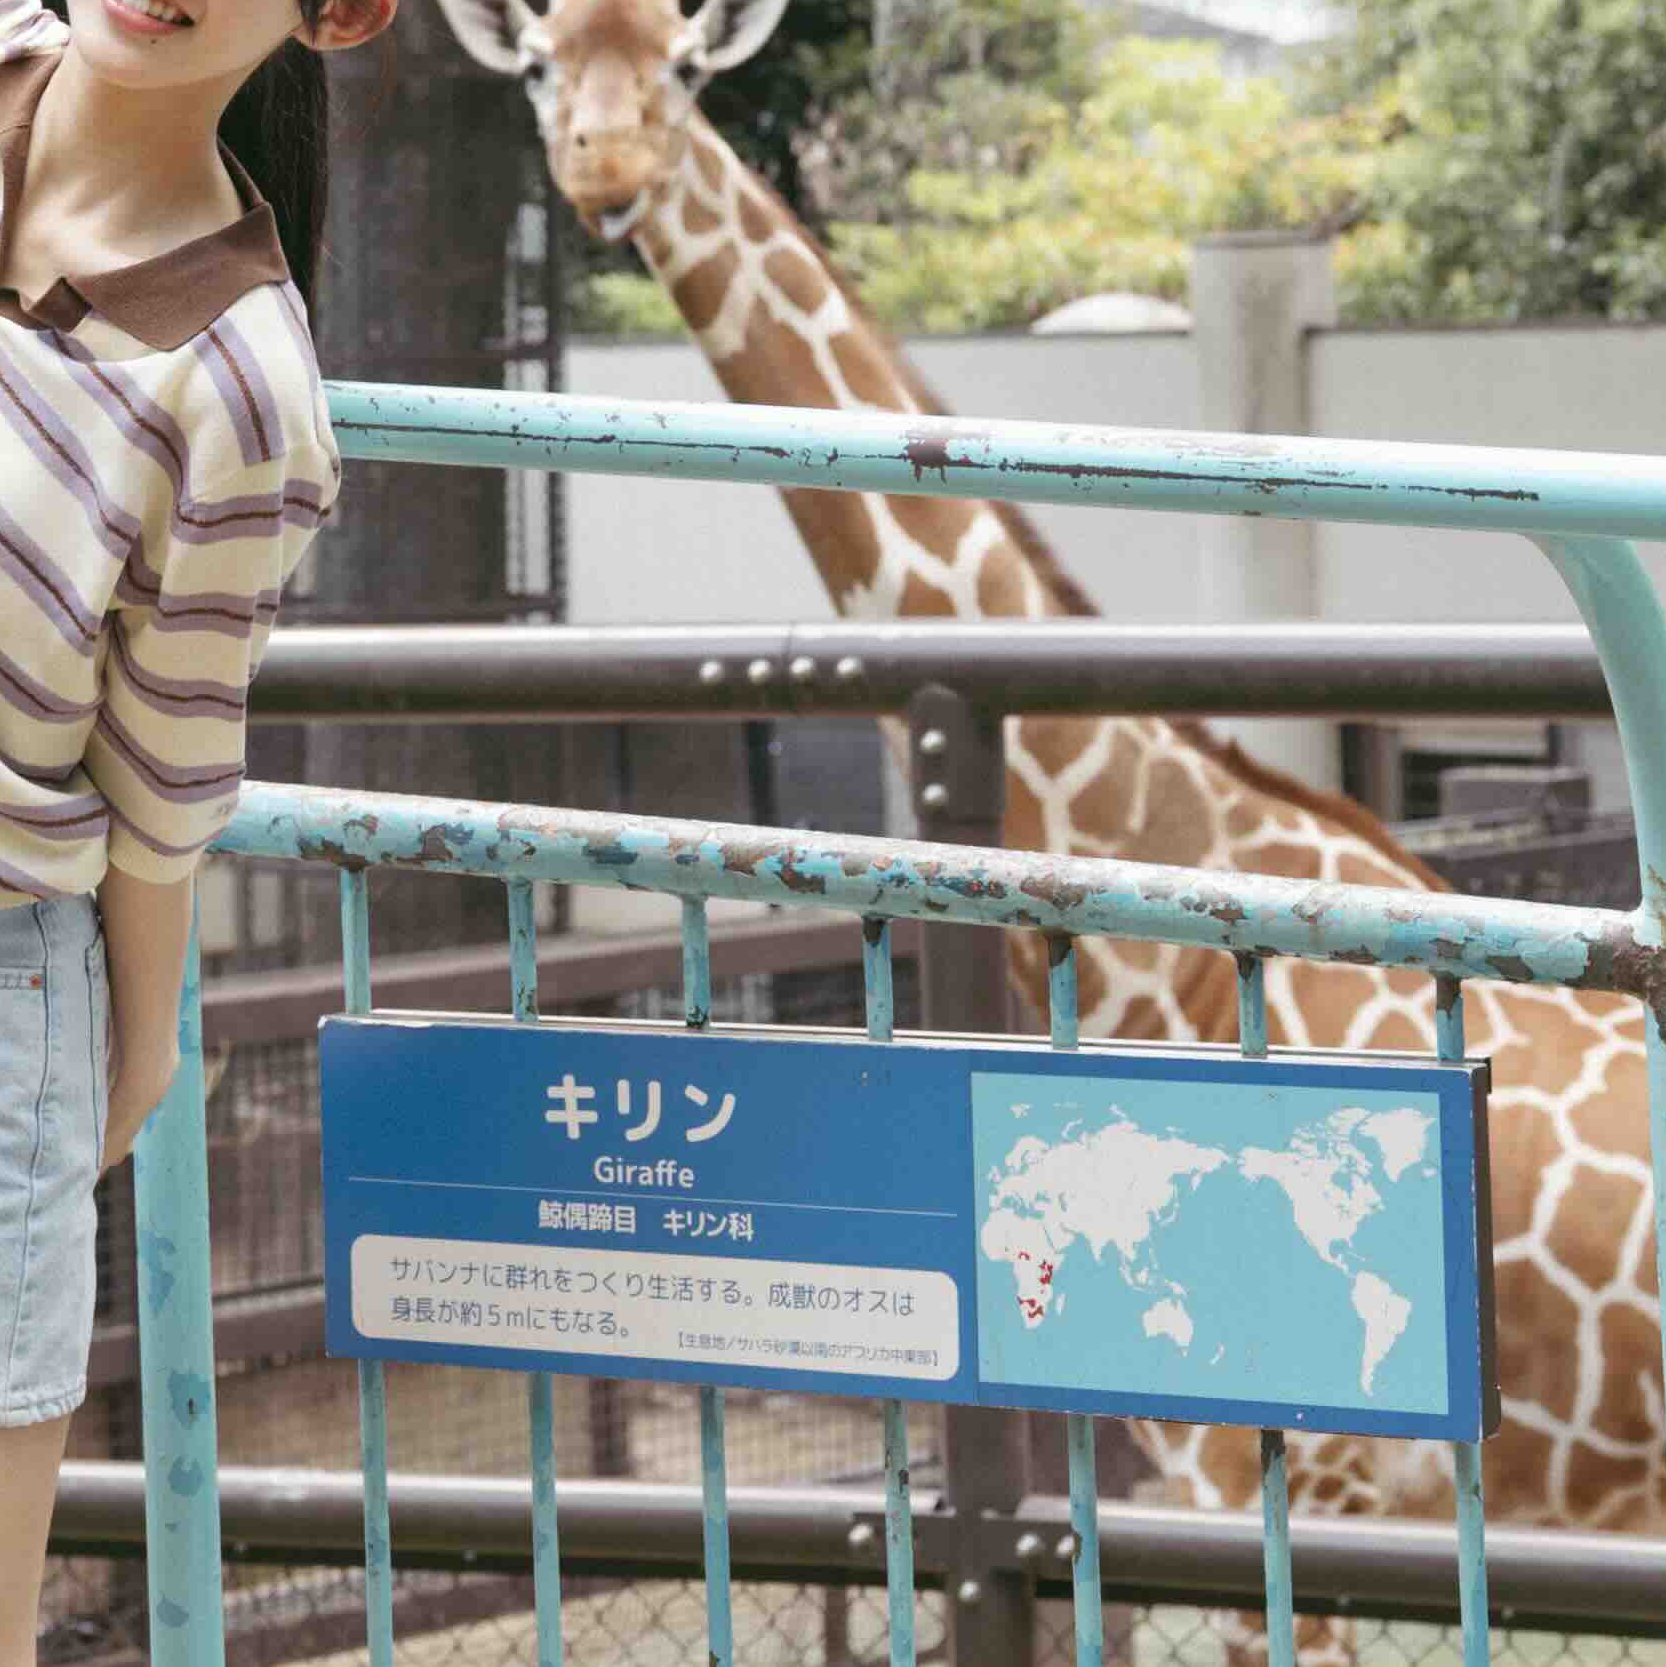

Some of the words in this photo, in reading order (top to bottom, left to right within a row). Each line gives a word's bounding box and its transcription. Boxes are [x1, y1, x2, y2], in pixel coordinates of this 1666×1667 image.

[545, 1074, 735, 1142] キリン
[593, 1155, 695, 1188] Giraffe
[538, 1199, 636, 1234] 鯨偶蹄目
[663, 1209, 754, 1241] キリン科
